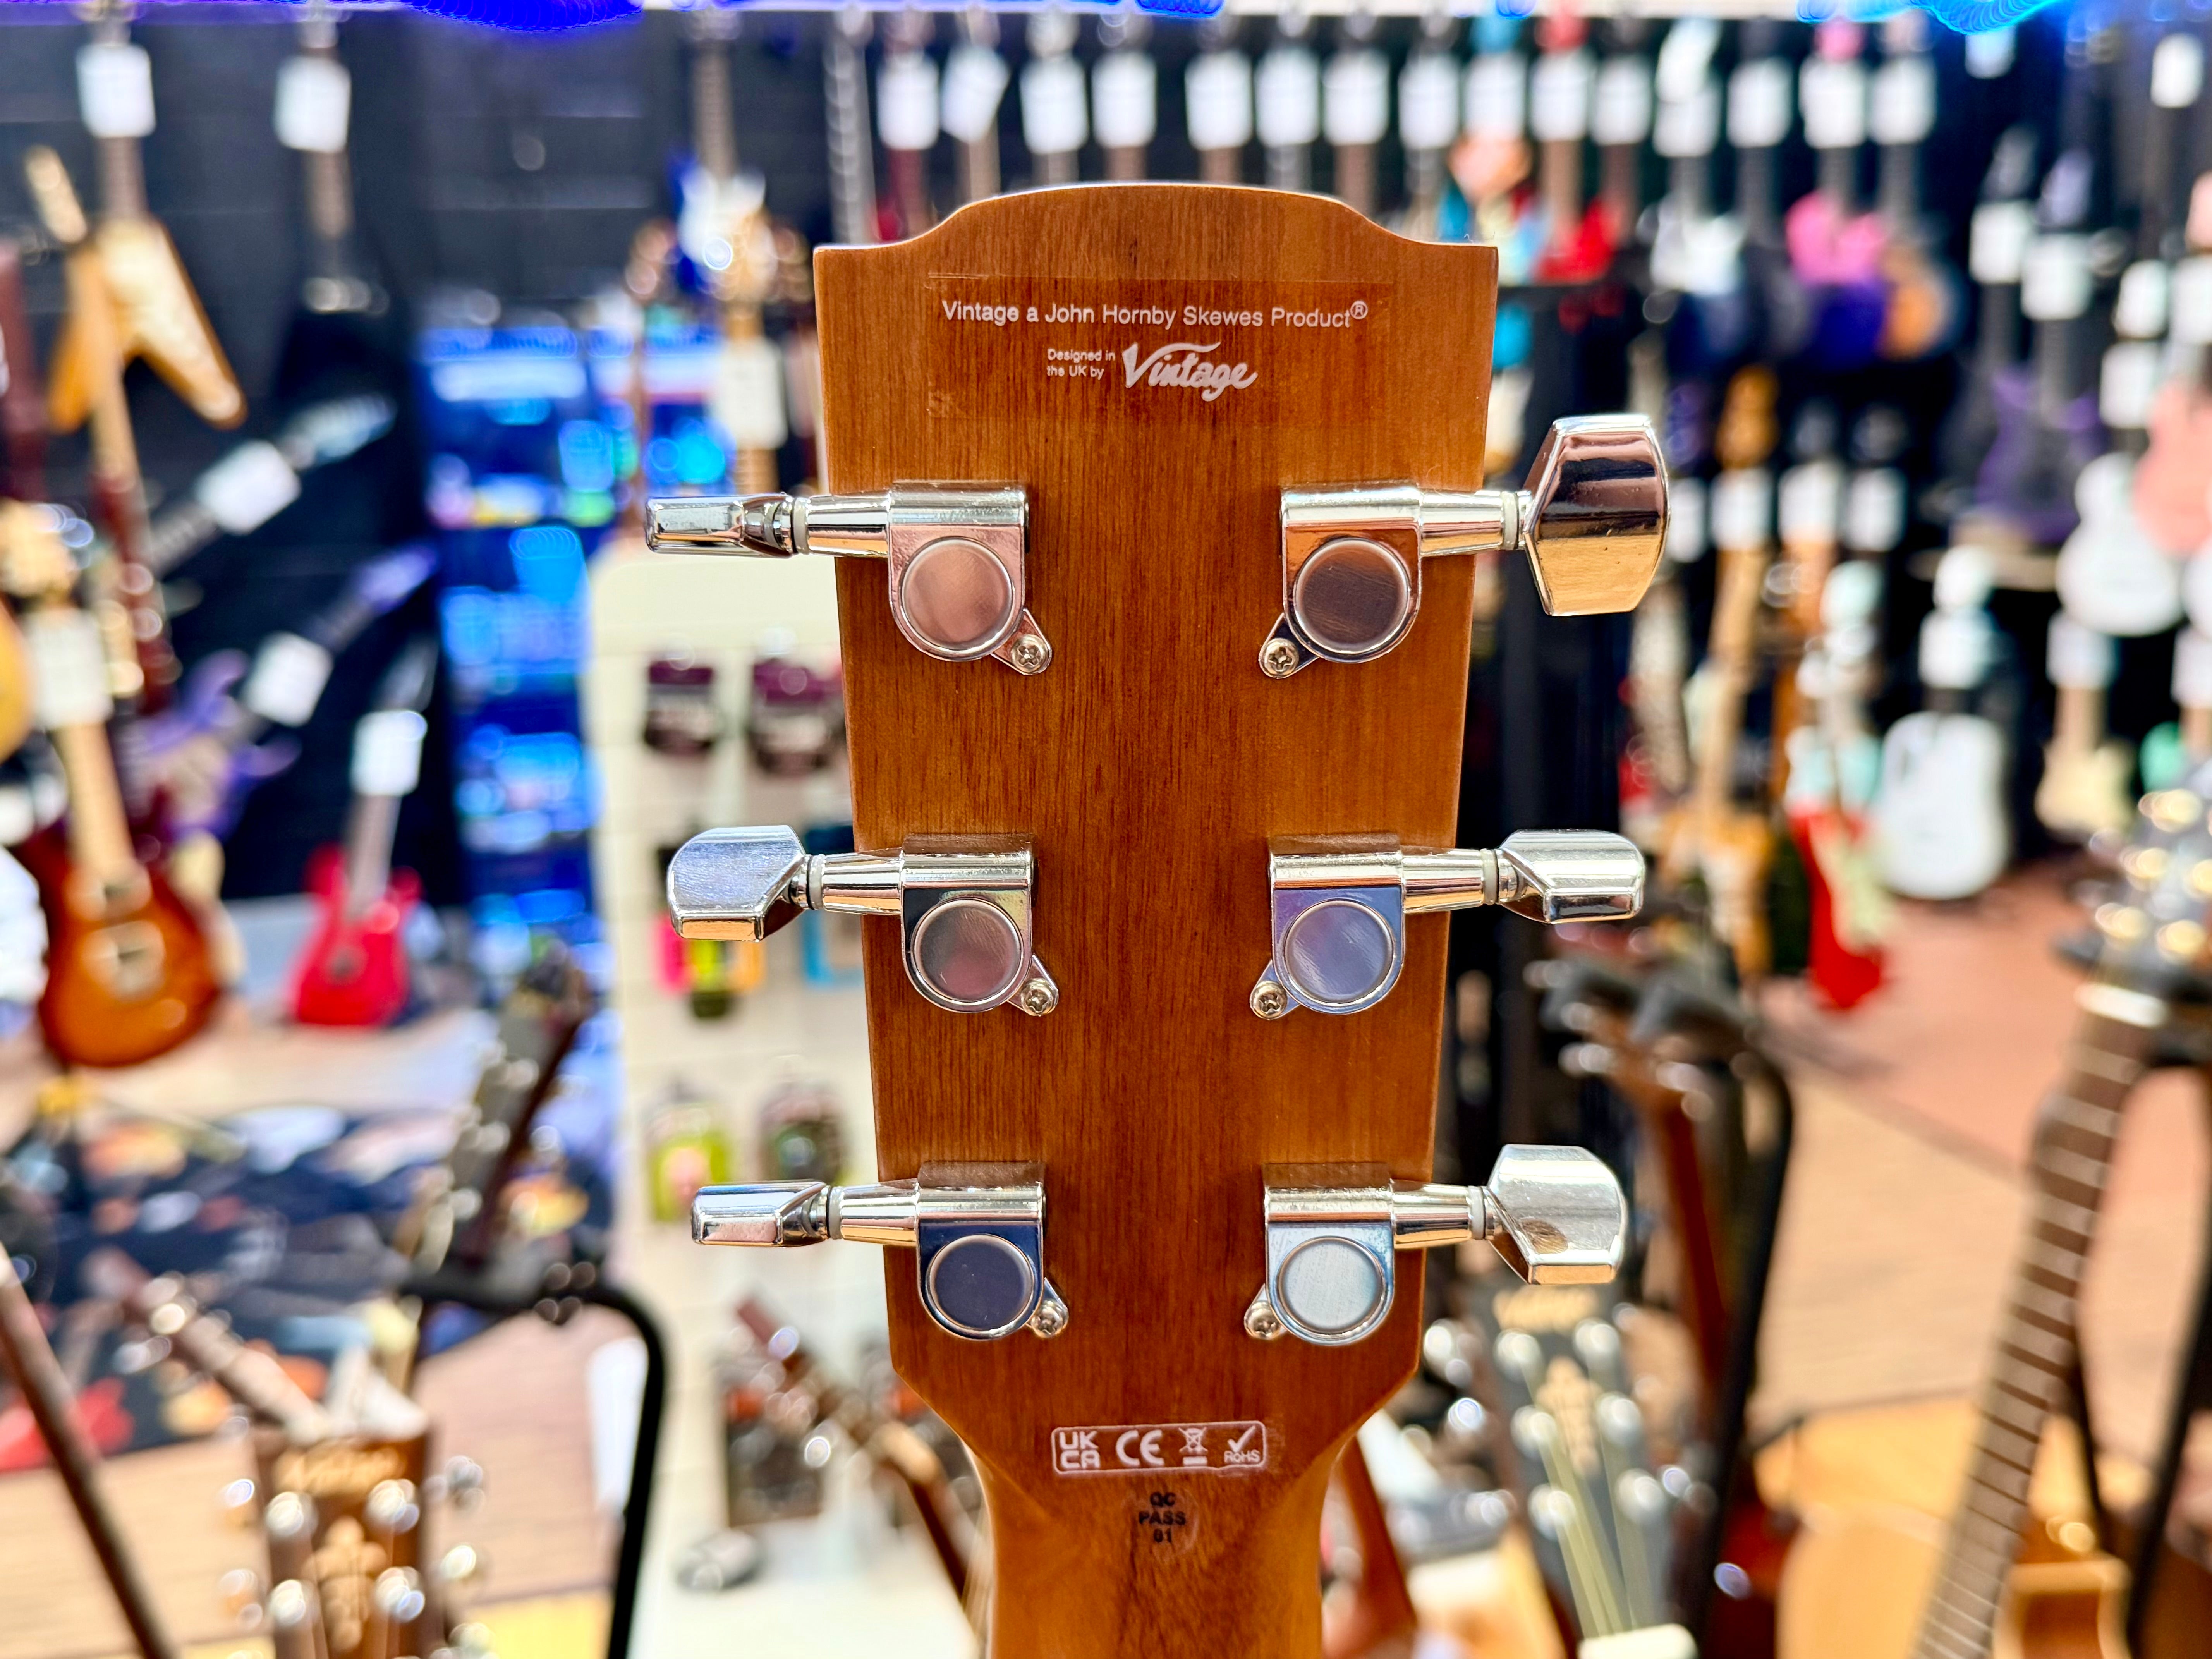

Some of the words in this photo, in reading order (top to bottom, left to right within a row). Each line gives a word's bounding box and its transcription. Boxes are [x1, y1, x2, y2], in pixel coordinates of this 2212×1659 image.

[941, 301, 1019, 326] Vintage
[1027, 307, 1039, 323] a
[1045, 303, 1095, 323] John
[1103, 304, 1175, 330] Hornby
[1183, 306, 1263, 327] Skewes
[1047, 348, 1103, 362] Designed
[1106, 349, 1116, 361] in
[1047, 365, 1065, 377] the
[1068, 366, 1086, 377] UK
[1089, 366, 1105, 379] by
[1121, 342, 1259, 402] Vintage
[1059, 1431, 1099, 1450] UK
[1116, 1429, 1165, 1467] CE
[1149, 1492, 1176, 1507] QC
[1139, 1511, 1186, 1526] PASS
